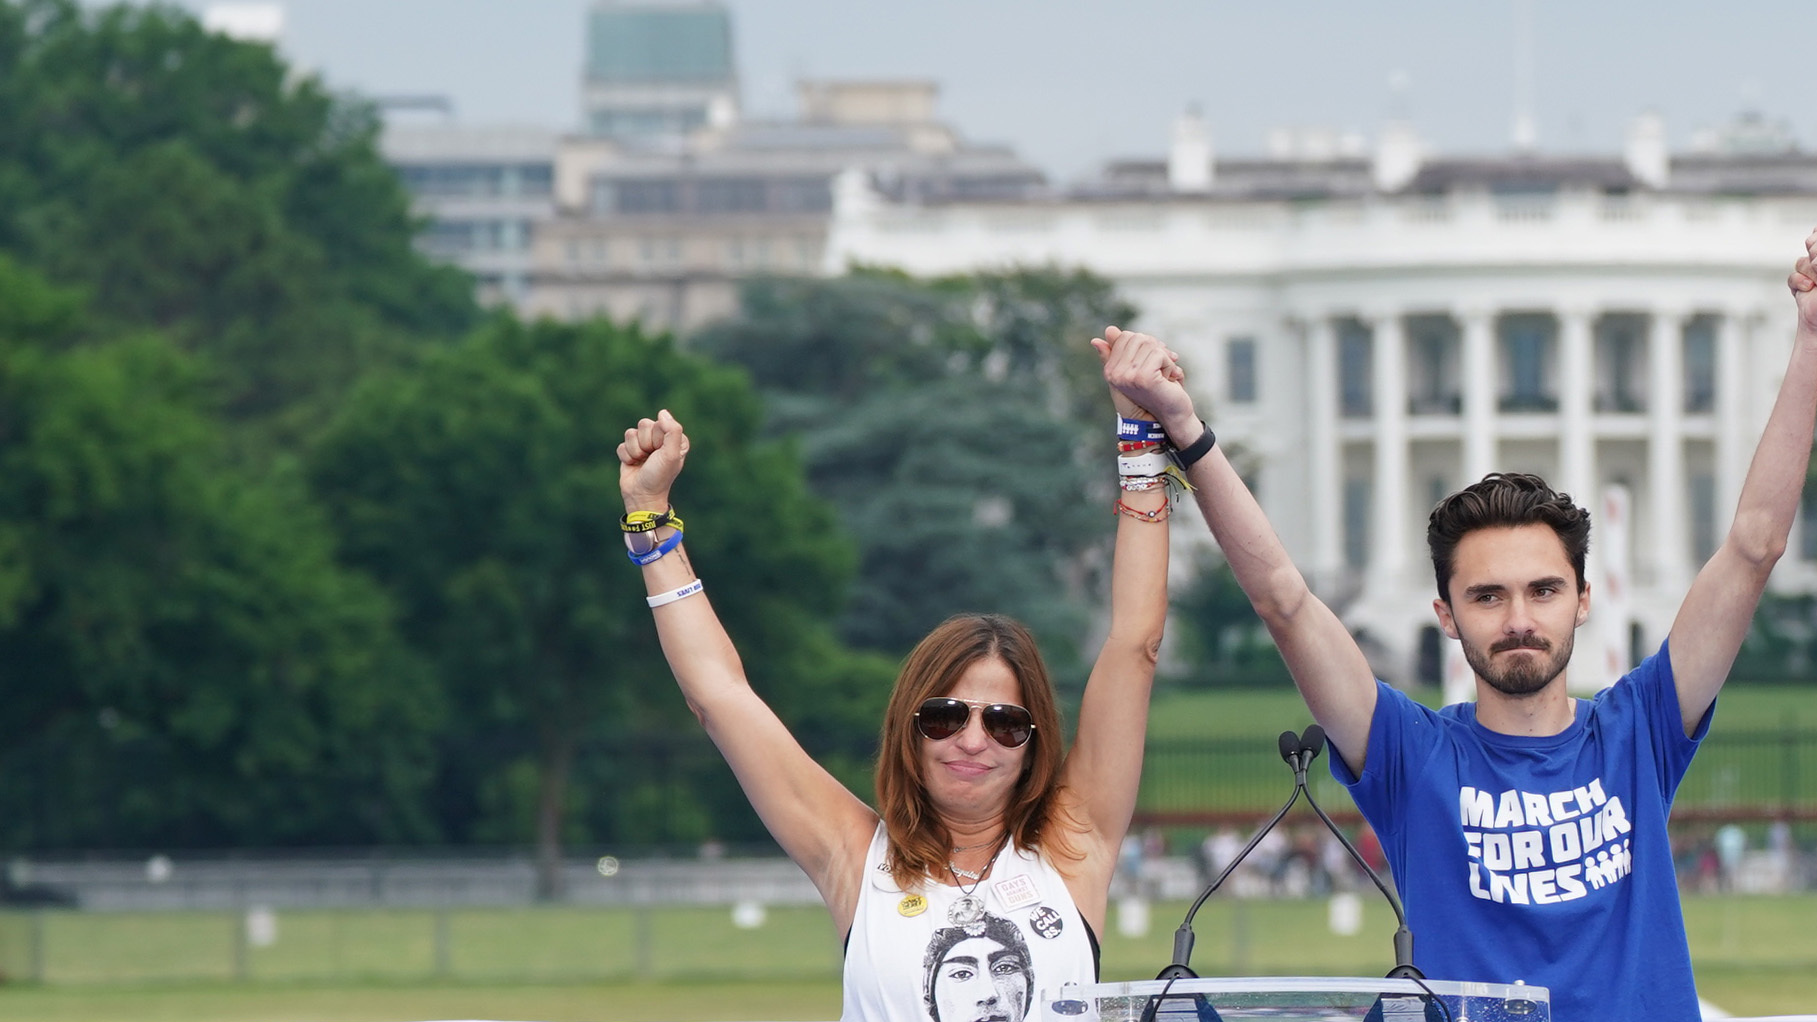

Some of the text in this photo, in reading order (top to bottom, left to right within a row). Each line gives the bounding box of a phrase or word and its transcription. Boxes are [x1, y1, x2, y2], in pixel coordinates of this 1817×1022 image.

[1460, 778, 1607, 828] MARCH
[1464, 796, 1632, 870] FOR OUR
[1001, 879, 1026, 892] GAYS
[1008, 891, 1034, 904] GUNS
[1030, 906, 1046, 921] WE
[1036, 911, 1060, 930] CALL
